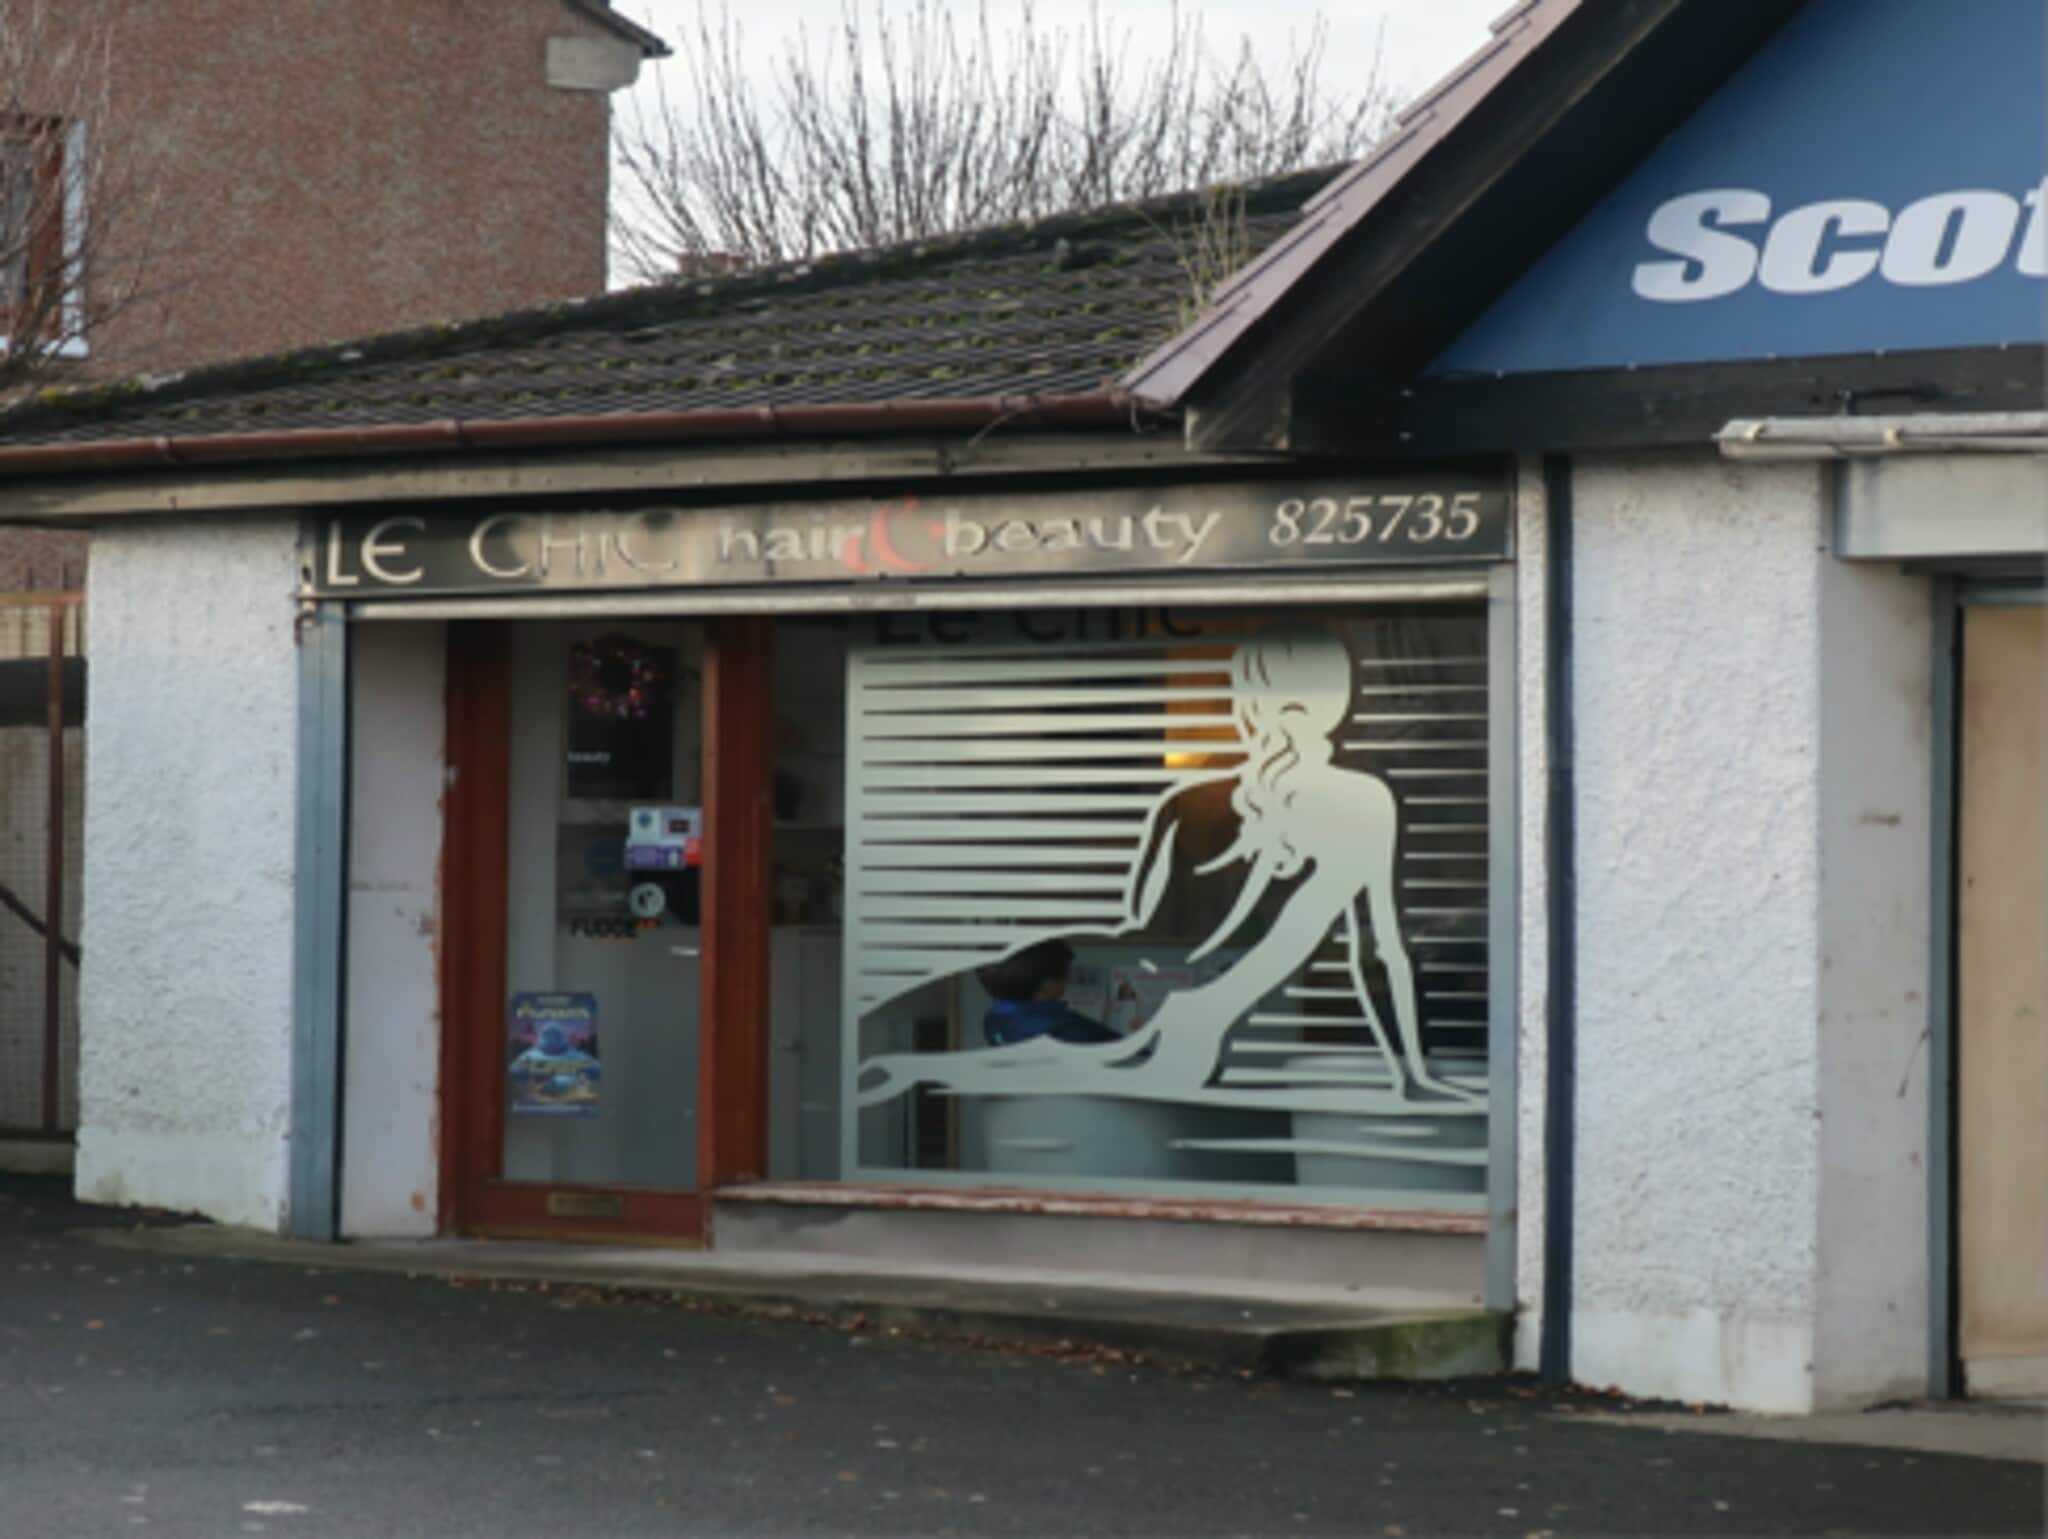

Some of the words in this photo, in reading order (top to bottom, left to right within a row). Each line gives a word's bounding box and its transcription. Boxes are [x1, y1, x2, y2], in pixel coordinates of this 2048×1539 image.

[326, 515, 427, 586] LE
[469, 508, 678, 580] CHIC
[718, 508, 866, 562] hair
[943, 503, 1222, 565] beauty
[1267, 492, 1482, 546] 825735
